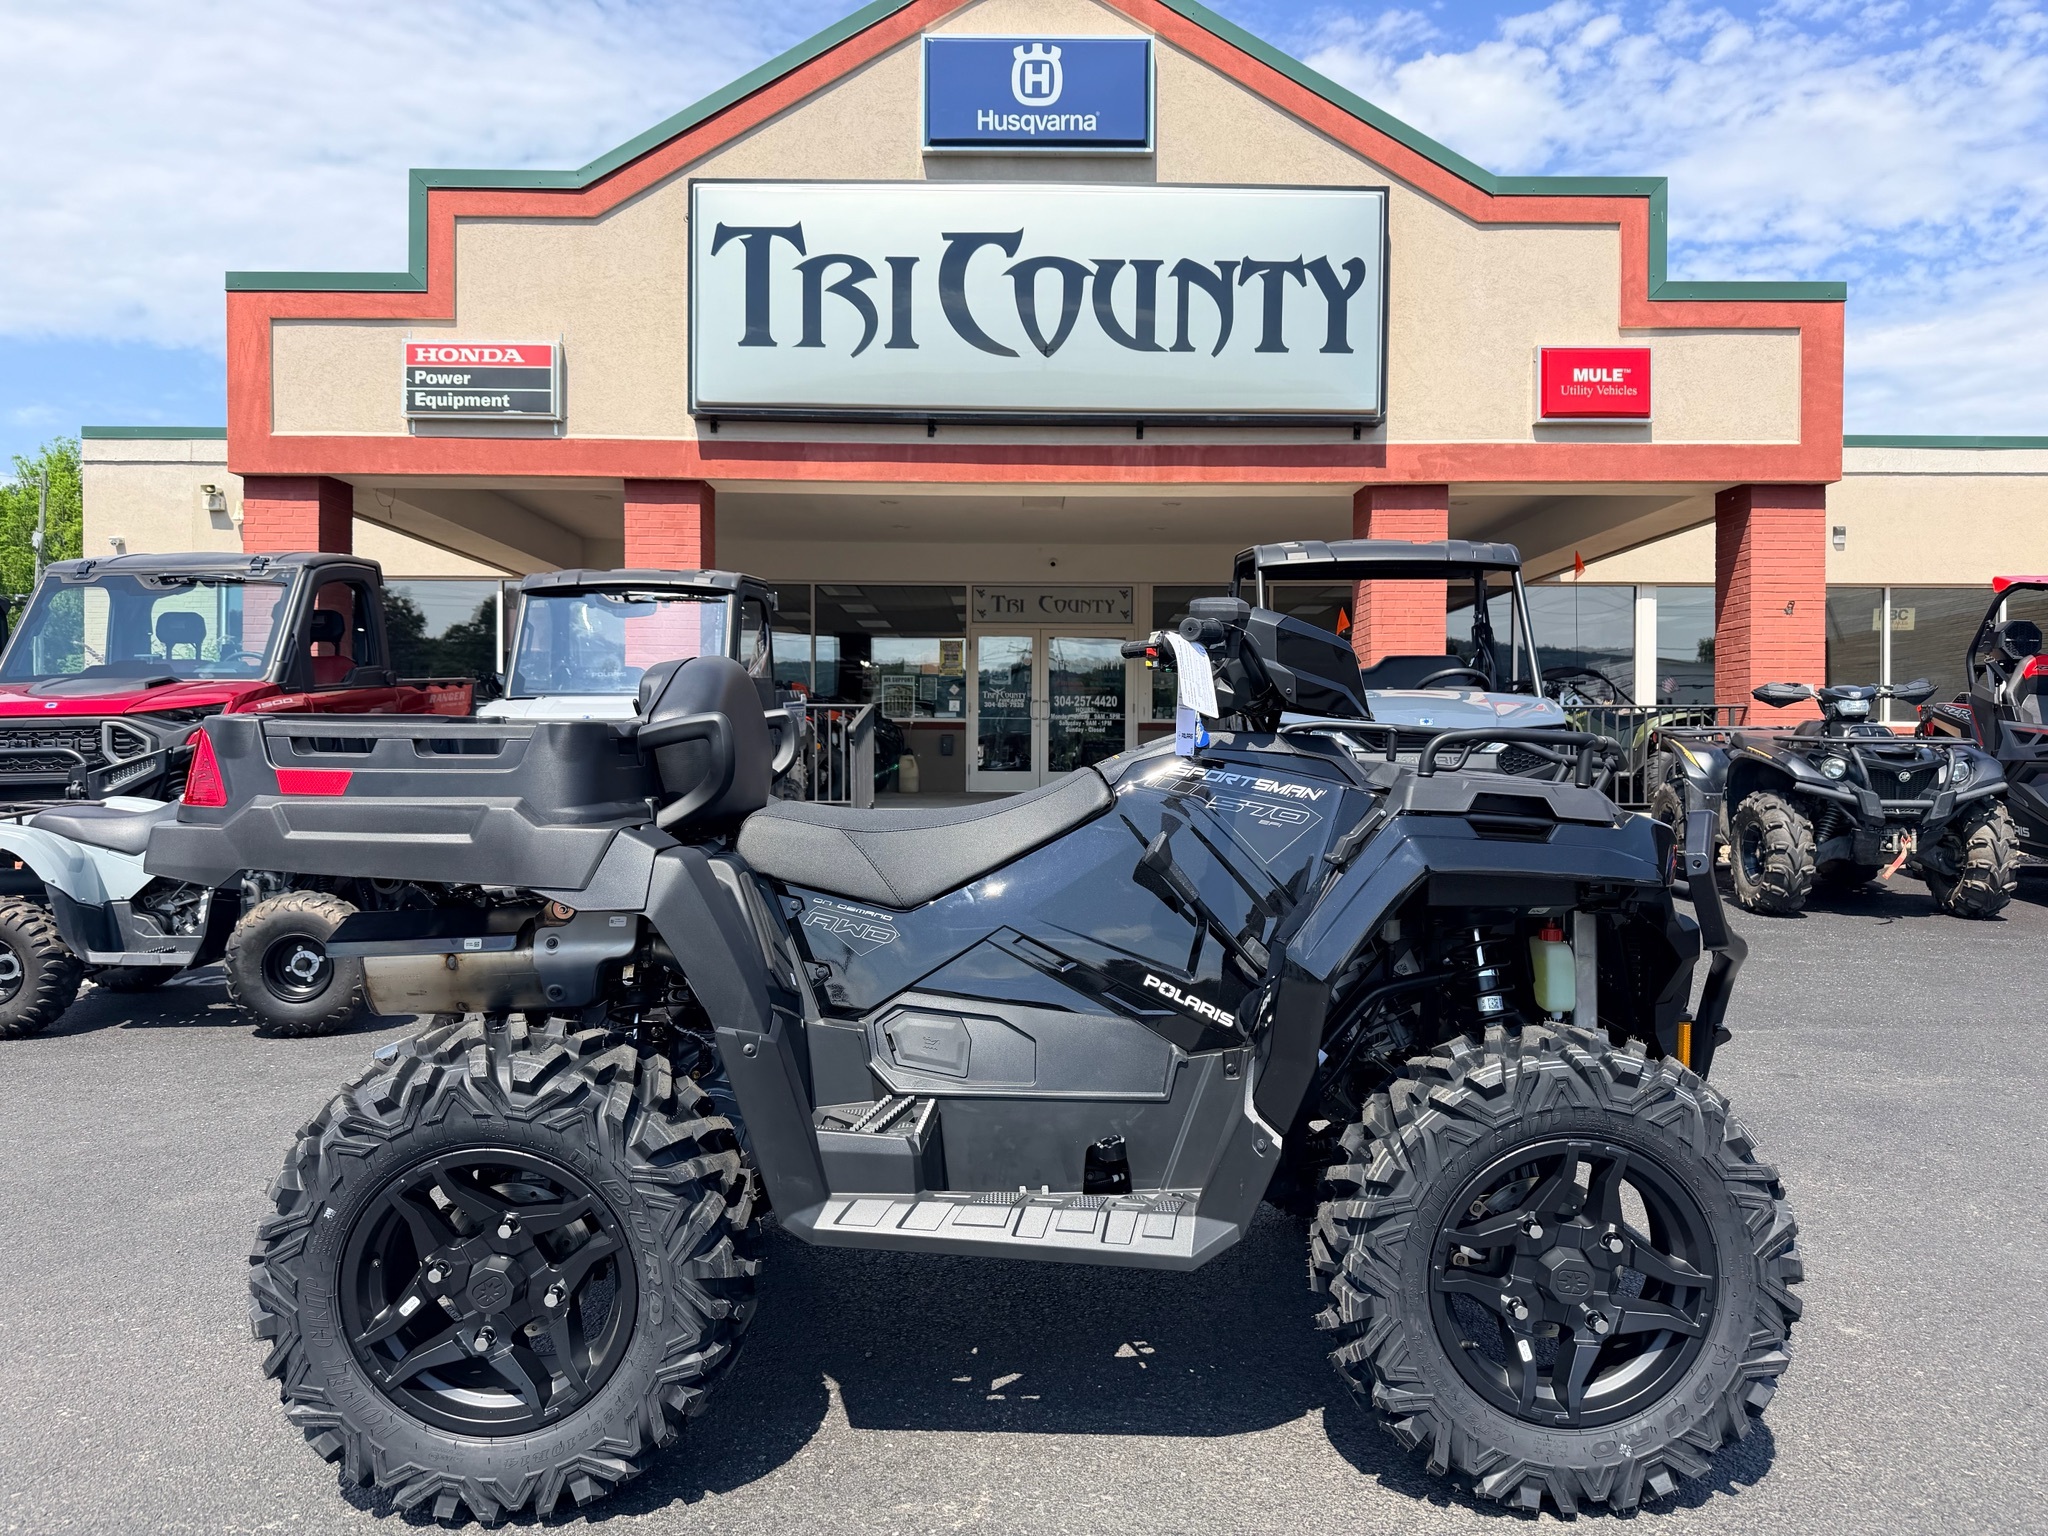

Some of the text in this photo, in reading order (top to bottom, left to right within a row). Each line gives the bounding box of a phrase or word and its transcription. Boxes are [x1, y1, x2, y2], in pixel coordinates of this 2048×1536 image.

[977, 109, 1098, 135] Husqvarna
[941, 227, 1366, 358] COUNTY
[415, 347, 526, 363] HONDA
[414, 370, 471, 385] Power
[414, 392, 510, 409] Equipment
[1560, 385, 1638, 398] Utility Vehicles
[1038, 595, 1116, 614] COUNTY
[256, 698, 293, 709] 1500
[429, 691, 466, 703] RANGER
[1054, 695, 1118, 707] 304-257-4420
[1167, 764, 1328, 801] SPORTSMAN
[836, 903, 894, 921] DEMAND
[803, 911, 898, 944] AWD
[1143, 973, 1236, 1028] POLARIS
[599, 1178, 665, 1327] DURO
